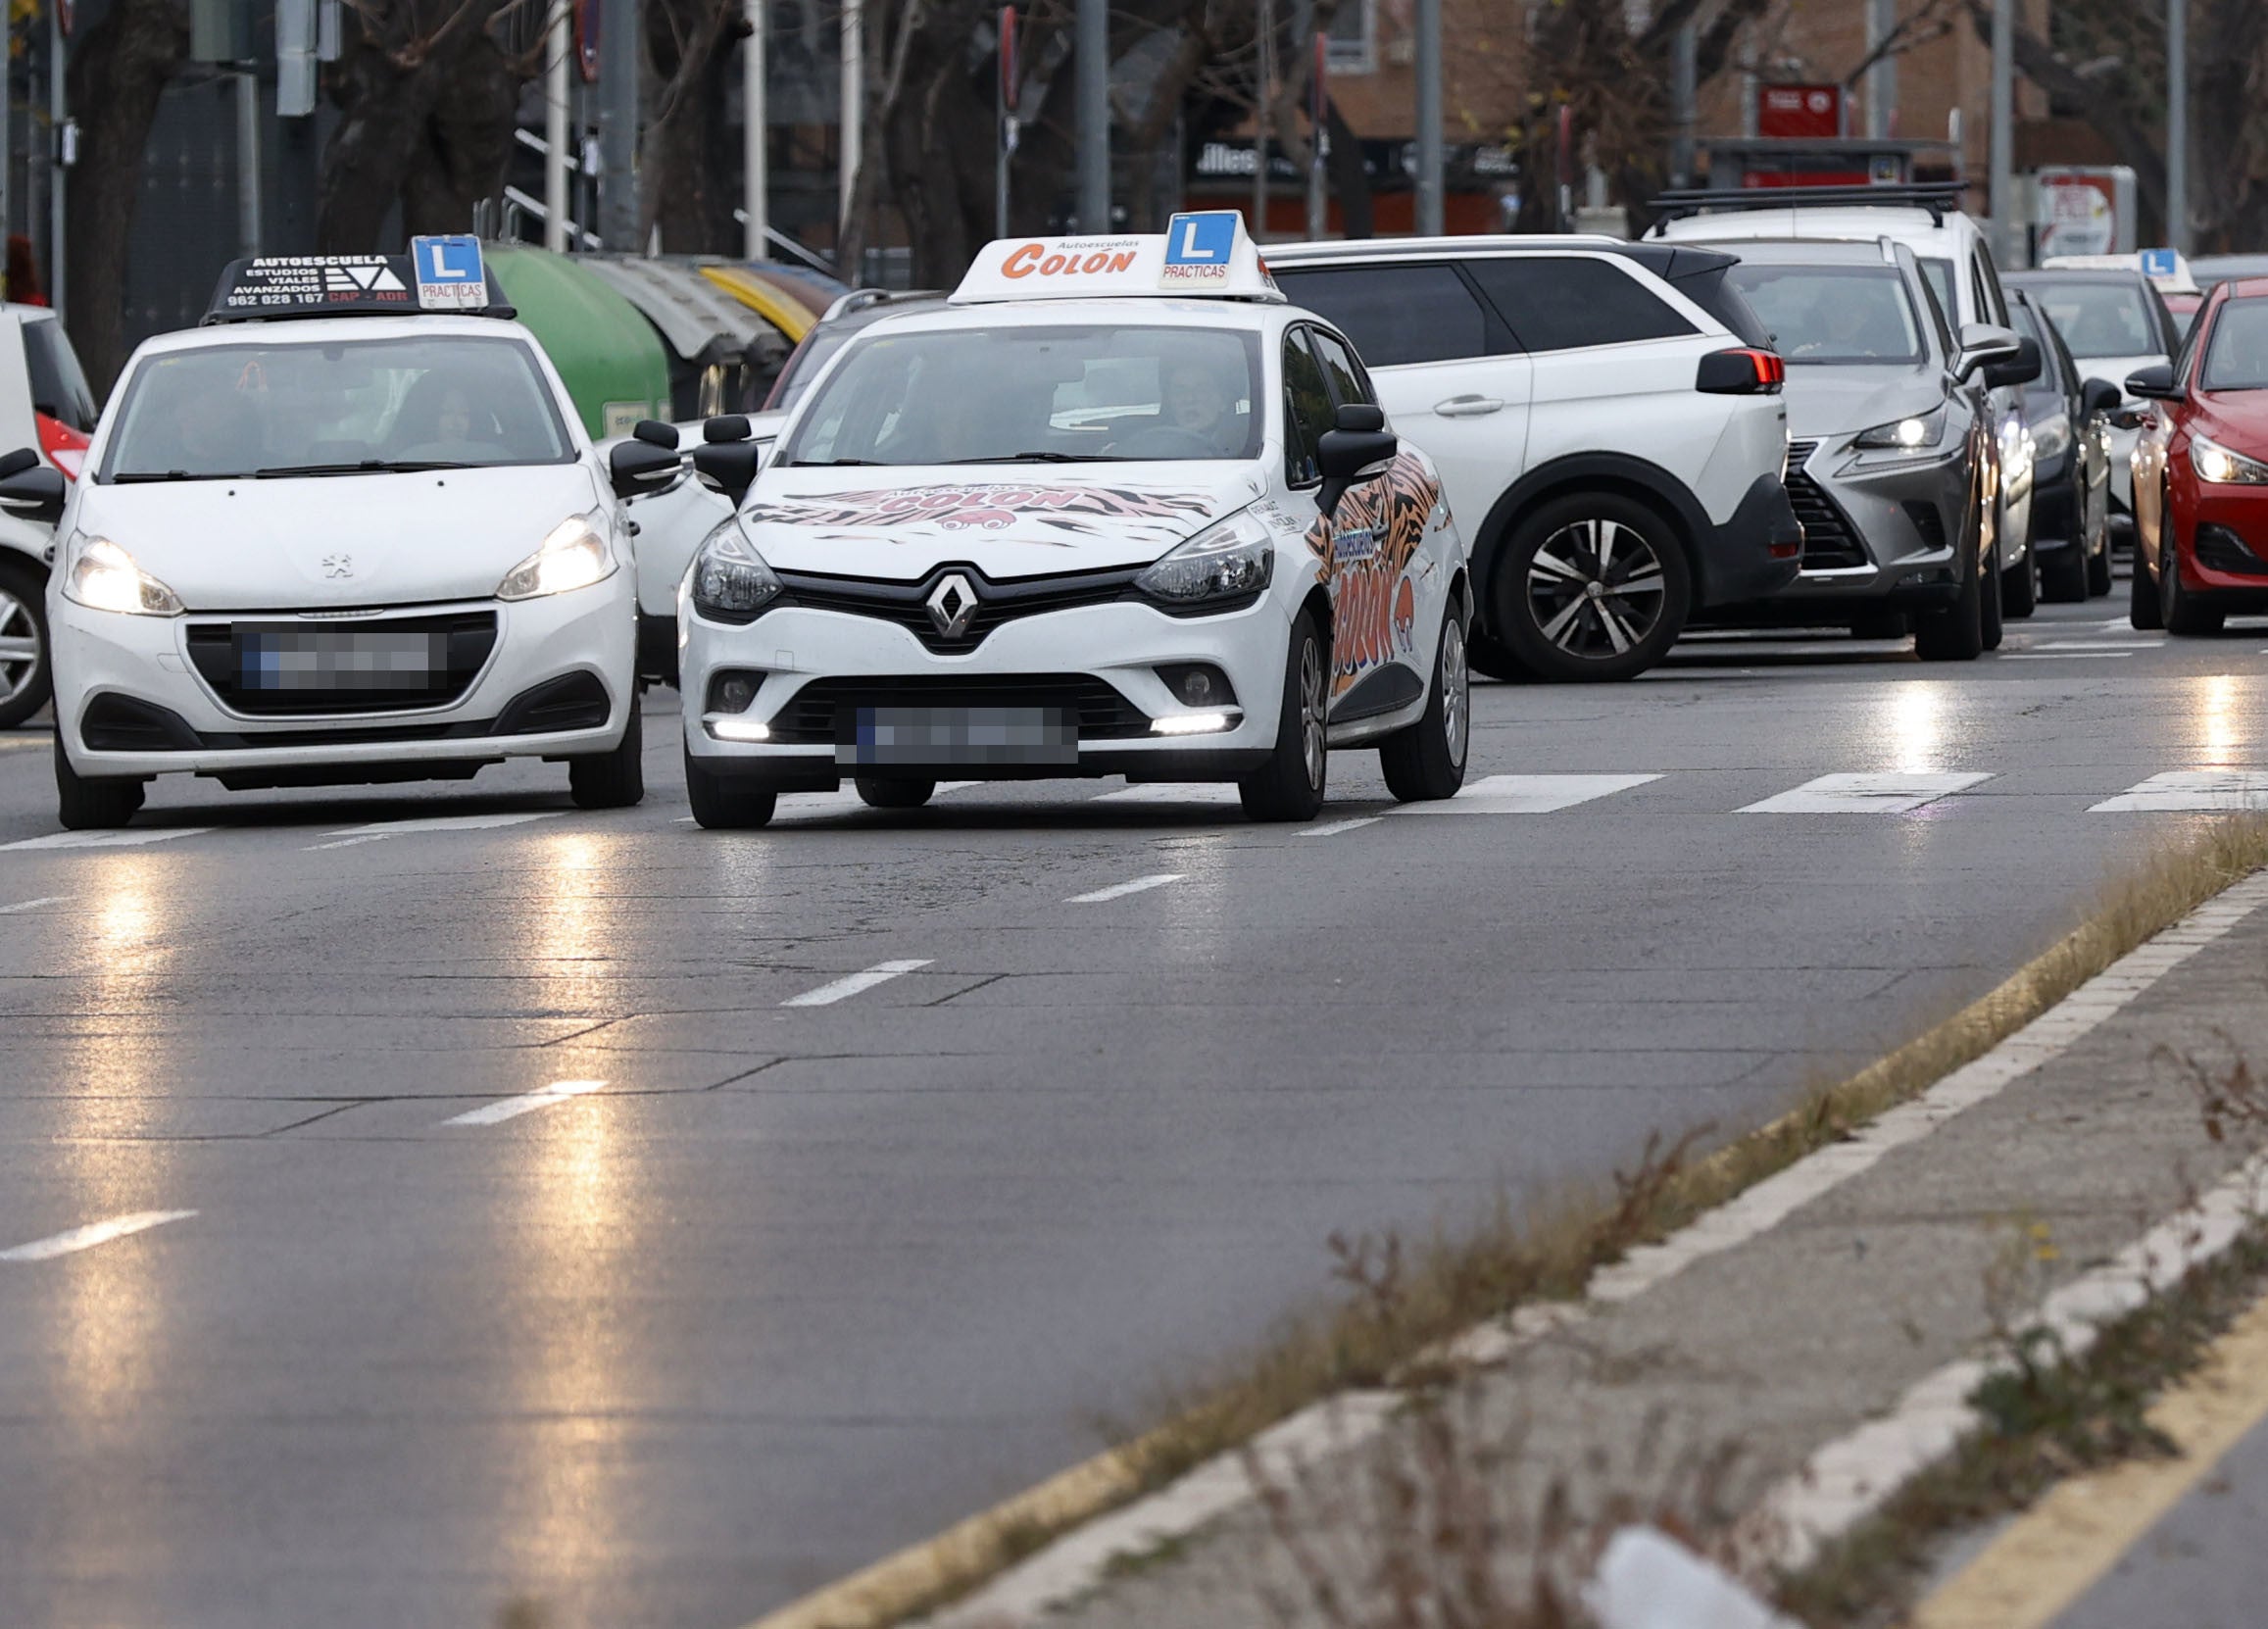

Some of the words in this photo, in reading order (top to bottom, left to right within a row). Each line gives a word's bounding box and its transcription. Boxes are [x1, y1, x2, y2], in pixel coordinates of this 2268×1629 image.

[1057, 239, 1140, 251] Autoescuelas
[1180, 222, 1214, 258] L
[252, 255, 388, 268] AUTOESCUELA
[431, 245, 468, 277] L
[2147, 253, 2167, 273] L
[246, 268, 319, 276] ESTUDIOS
[1162, 264, 1226, 279] PRACTICAS
[268, 275, 320, 285] VIALES
[233, 284, 321, 295] AVANZADOS
[422, 284, 483, 299] PRACTICAS
[226, 295, 258, 307] 962
[261, 294, 292, 306] 028
[296, 293, 324, 304] 167
[328, 292, 361, 303] CAP
[375, 291, 409, 302] ADR
